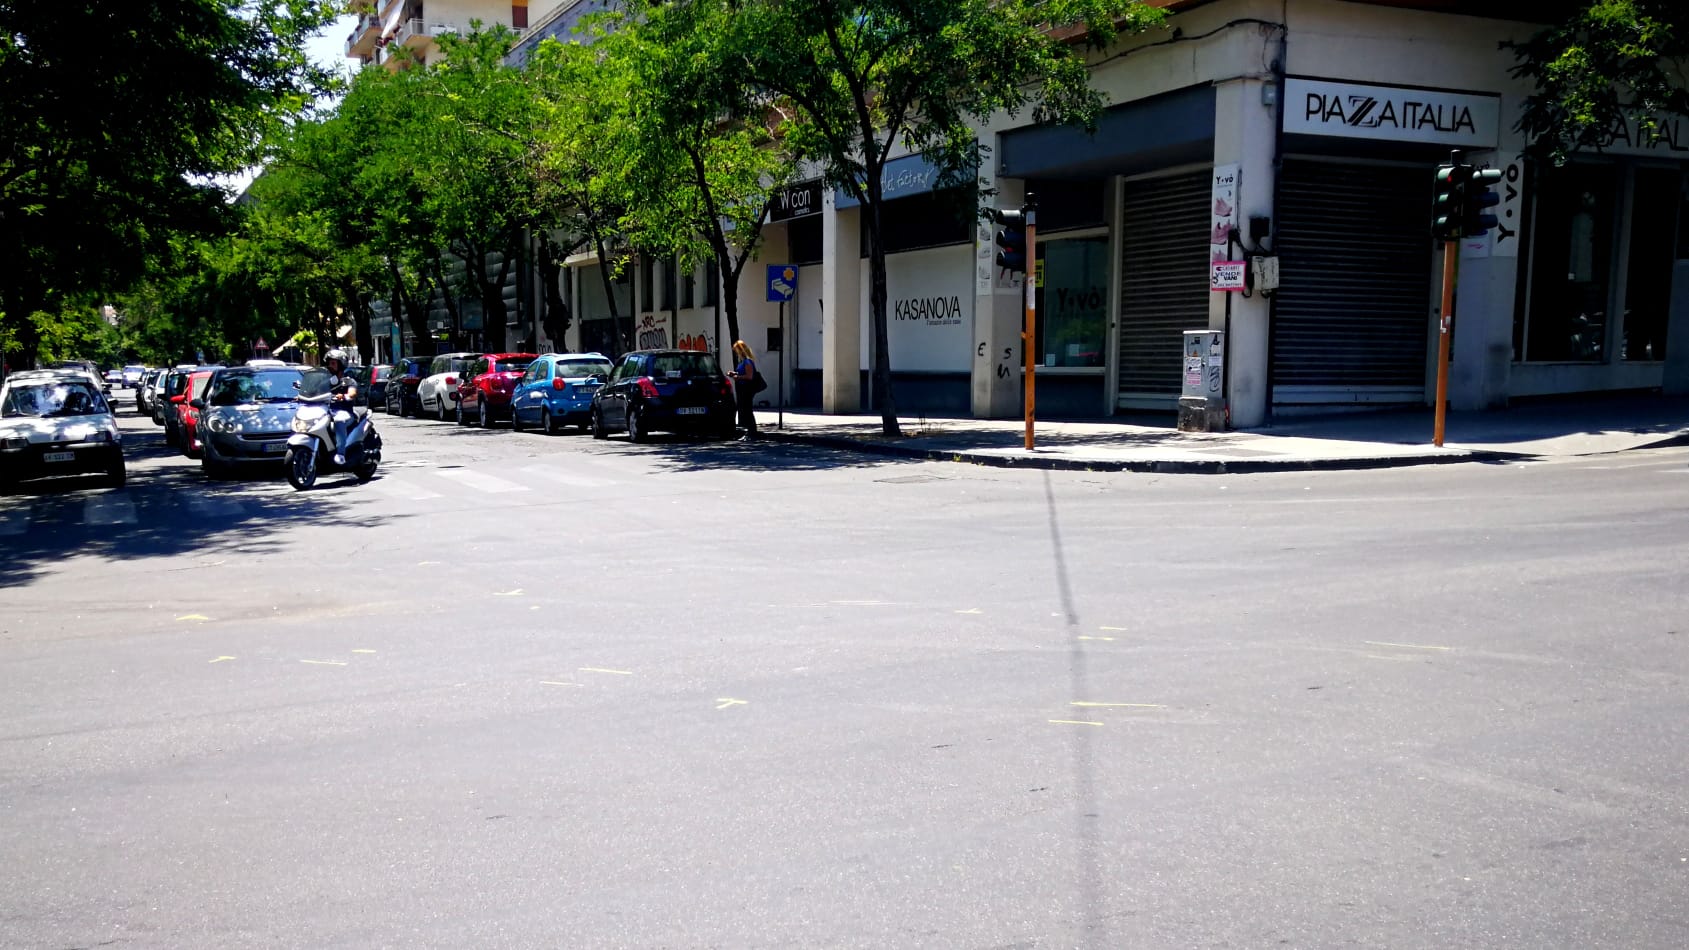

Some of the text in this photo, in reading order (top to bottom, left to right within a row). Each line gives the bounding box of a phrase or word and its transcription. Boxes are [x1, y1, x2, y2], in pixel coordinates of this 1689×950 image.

[1306, 93, 1475, 134] PIAZZA ITALIA
[895, 296, 961, 320] KASANOVA
